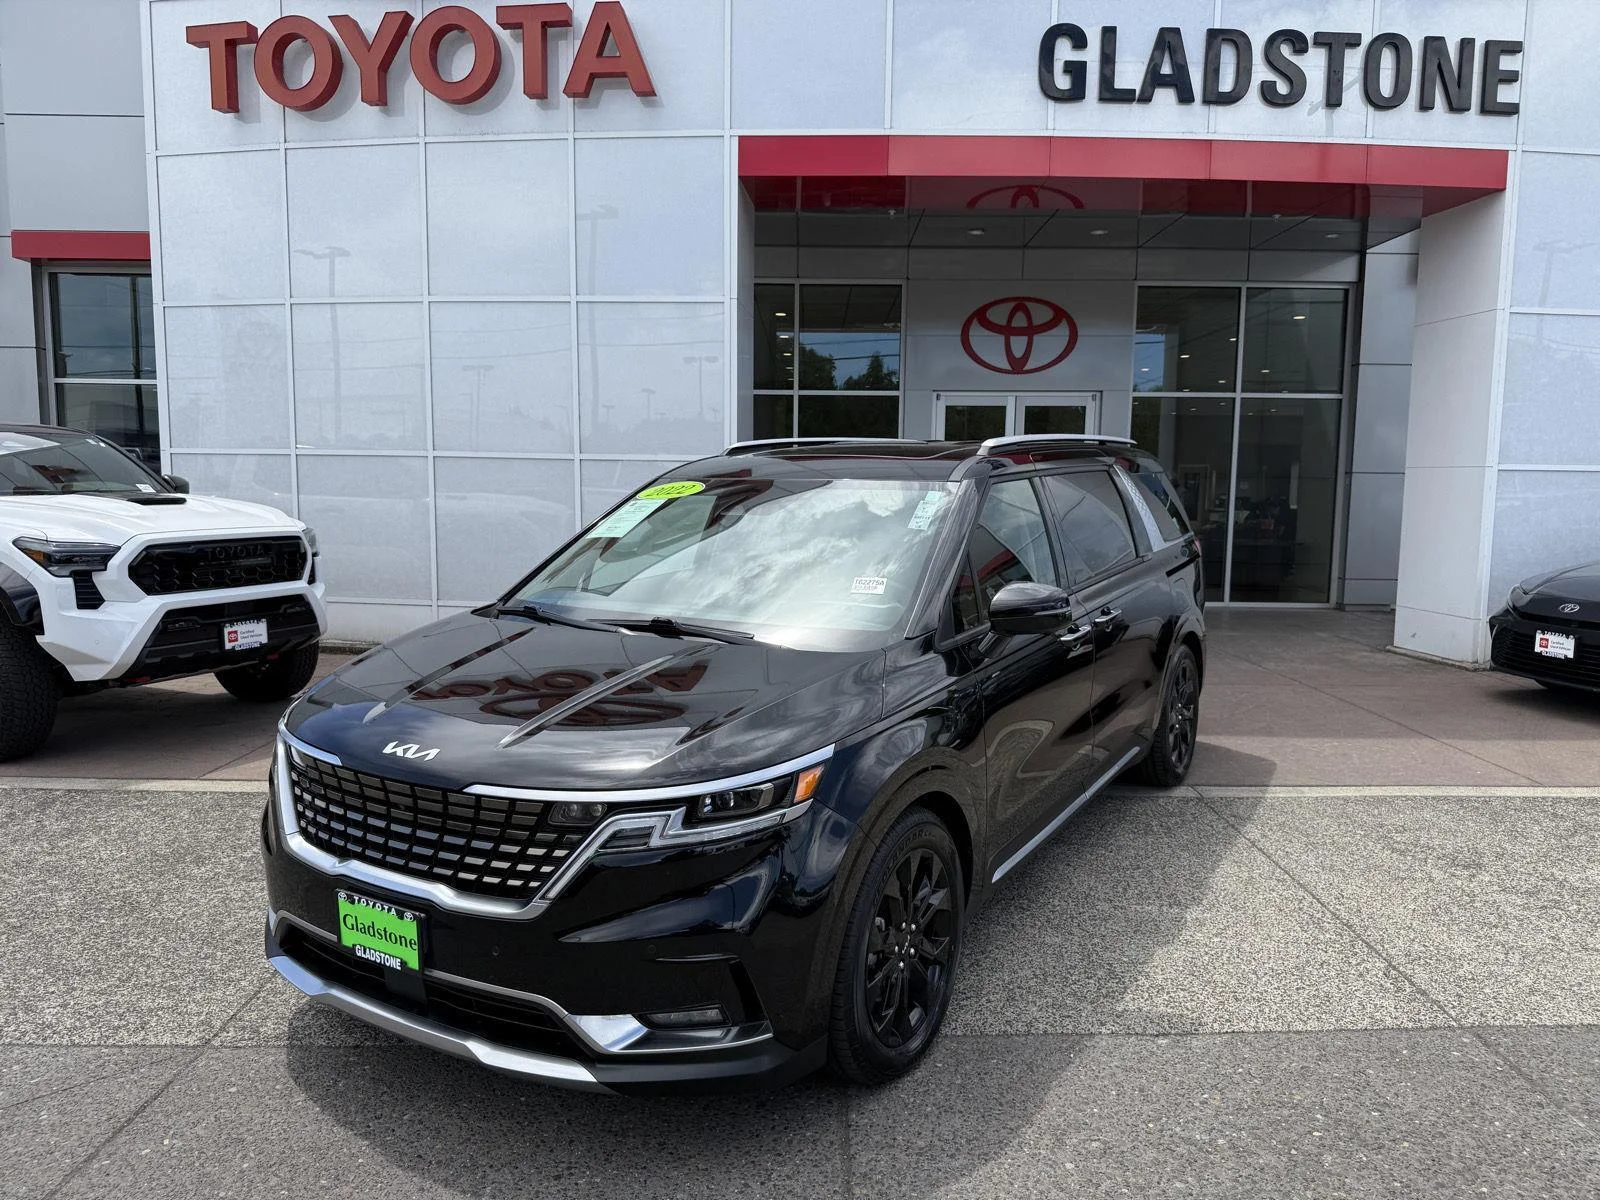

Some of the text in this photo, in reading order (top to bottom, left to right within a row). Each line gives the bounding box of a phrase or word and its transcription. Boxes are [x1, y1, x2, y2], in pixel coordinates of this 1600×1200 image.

[186, 1, 657, 113] TOYOTA
[1038, 22, 1524, 116] GLADSTONE
[382, 740, 441, 762] KIA
[353, 896, 397, 916] TOYOTA
[342, 913, 418, 951] Gladstone
[355, 944, 402, 970] GLADSTONE
